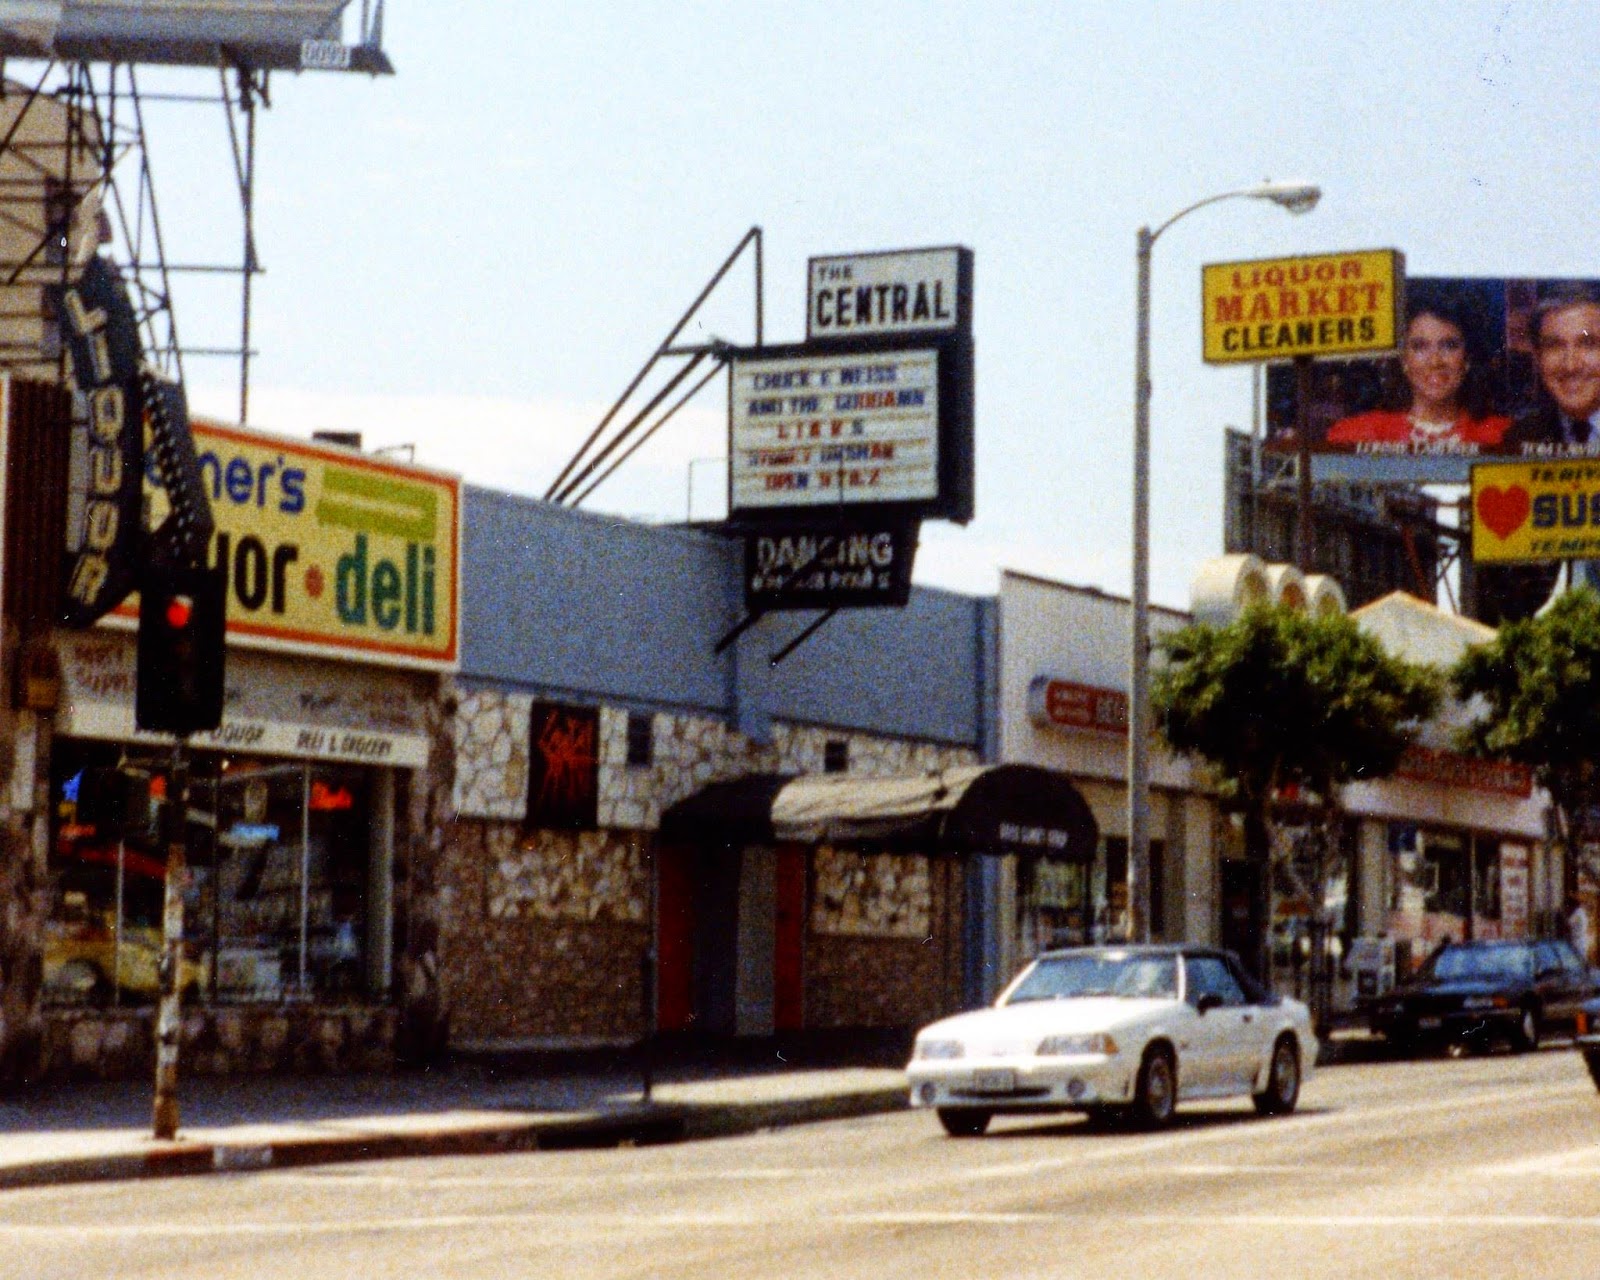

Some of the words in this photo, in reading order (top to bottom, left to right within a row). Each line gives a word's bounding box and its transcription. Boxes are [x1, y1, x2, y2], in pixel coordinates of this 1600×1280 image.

[818, 265, 852, 279] THE
[1232, 260, 1362, 290] LIQUOR
[817, 280, 949, 326] CENTRAL
[1215, 282, 1383, 322] MARKET
[1222, 317, 1376, 351] CLEANERS
[337, 530, 436, 635] deli
